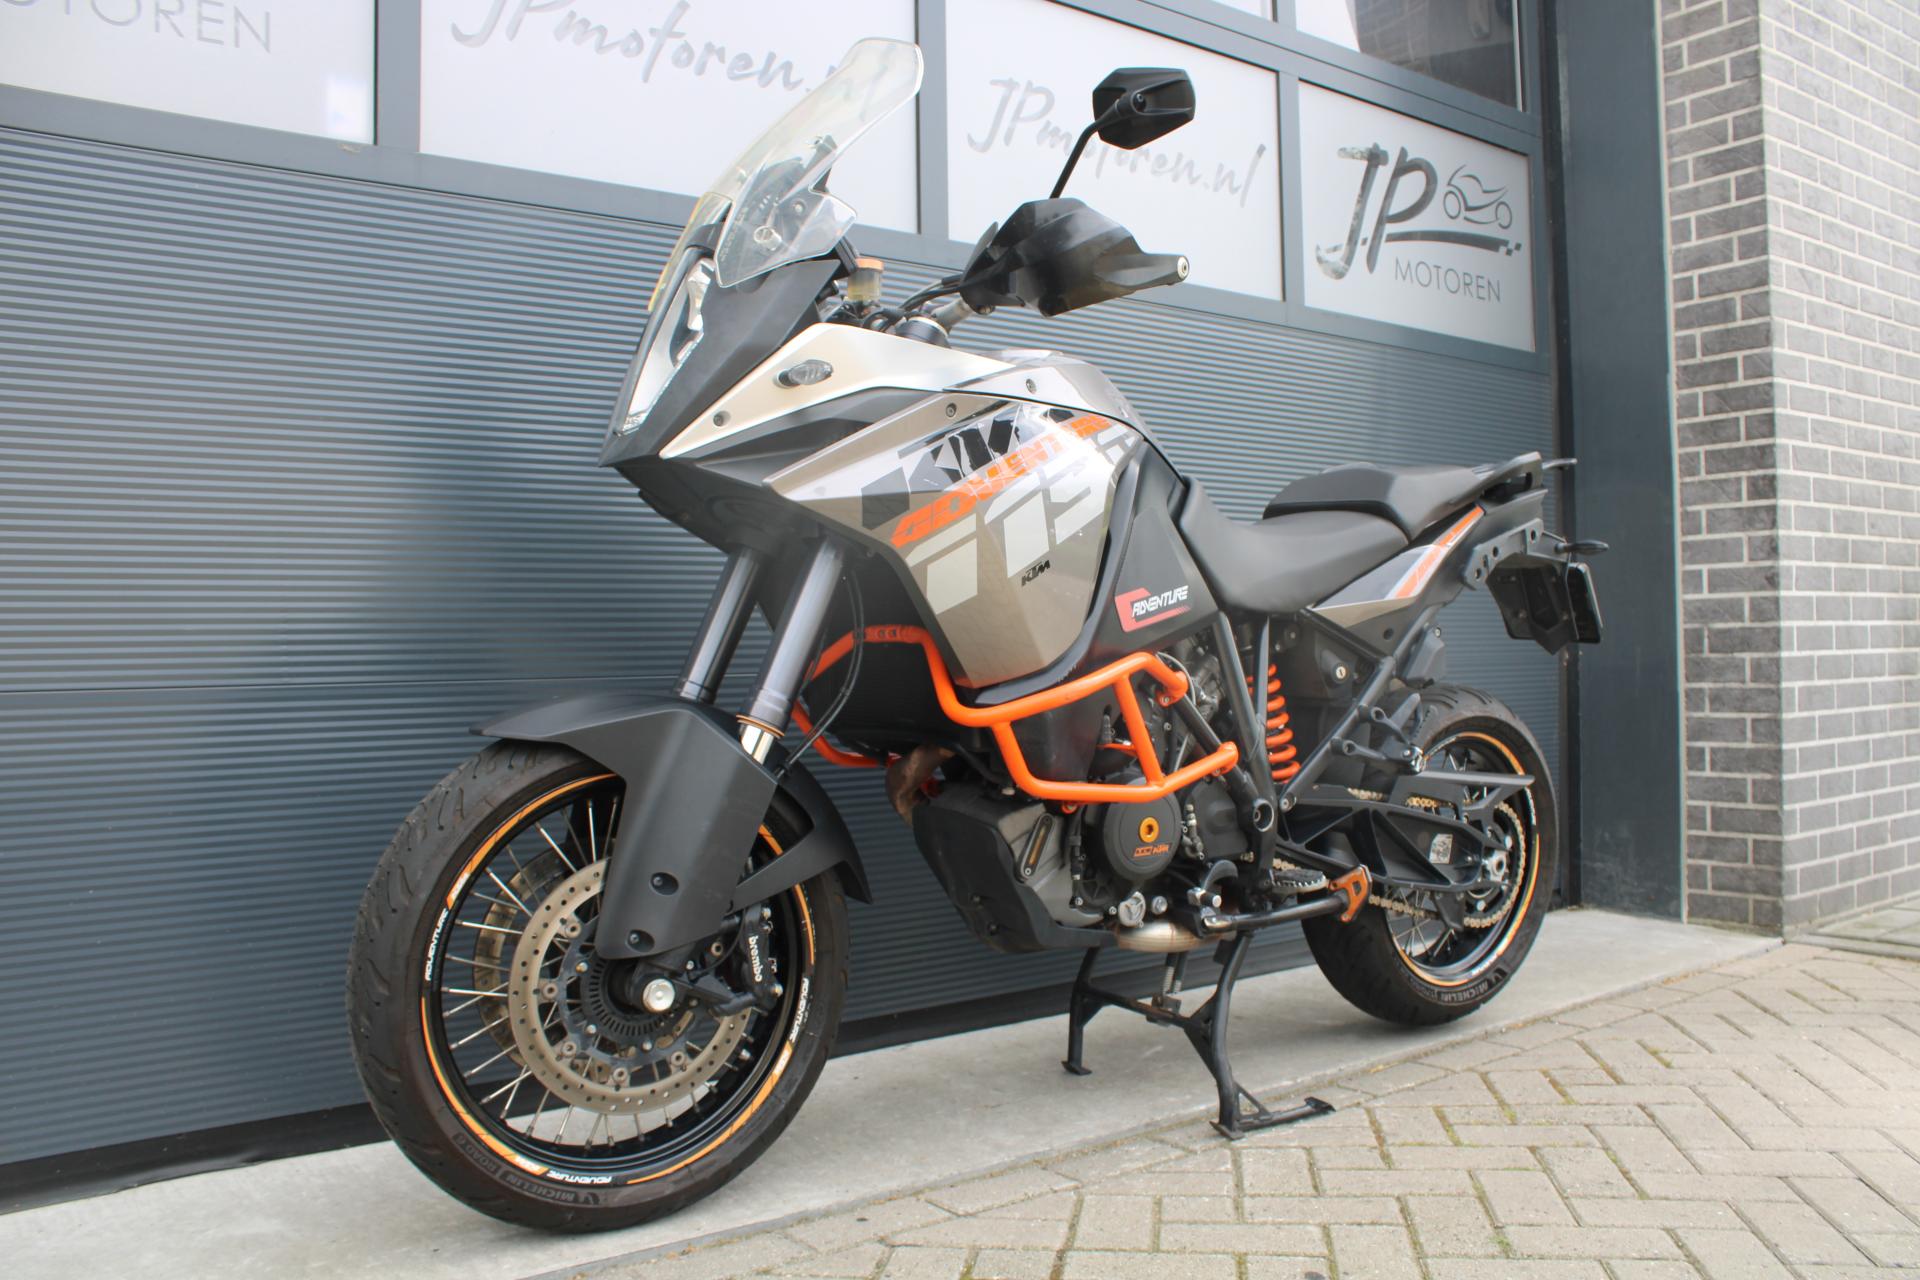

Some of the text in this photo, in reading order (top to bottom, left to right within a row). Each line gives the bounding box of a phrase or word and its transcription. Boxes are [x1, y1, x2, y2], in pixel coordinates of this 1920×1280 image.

[0, 0, 271, 53] OREN
[1395, 257, 1501, 302] MOTOREN
[1021, 559, 1050, 587] KTM
[1131, 585, 1189, 618] ADVENTURE
[749, 935, 763, 982] brembo
[1441, 980, 1489, 1003] MICHELIN
[464, 1144, 496, 1172] ROAD
[506, 1174, 576, 1201] MICHELIN
[546, 1169, 613, 1184] ADVENTURE
